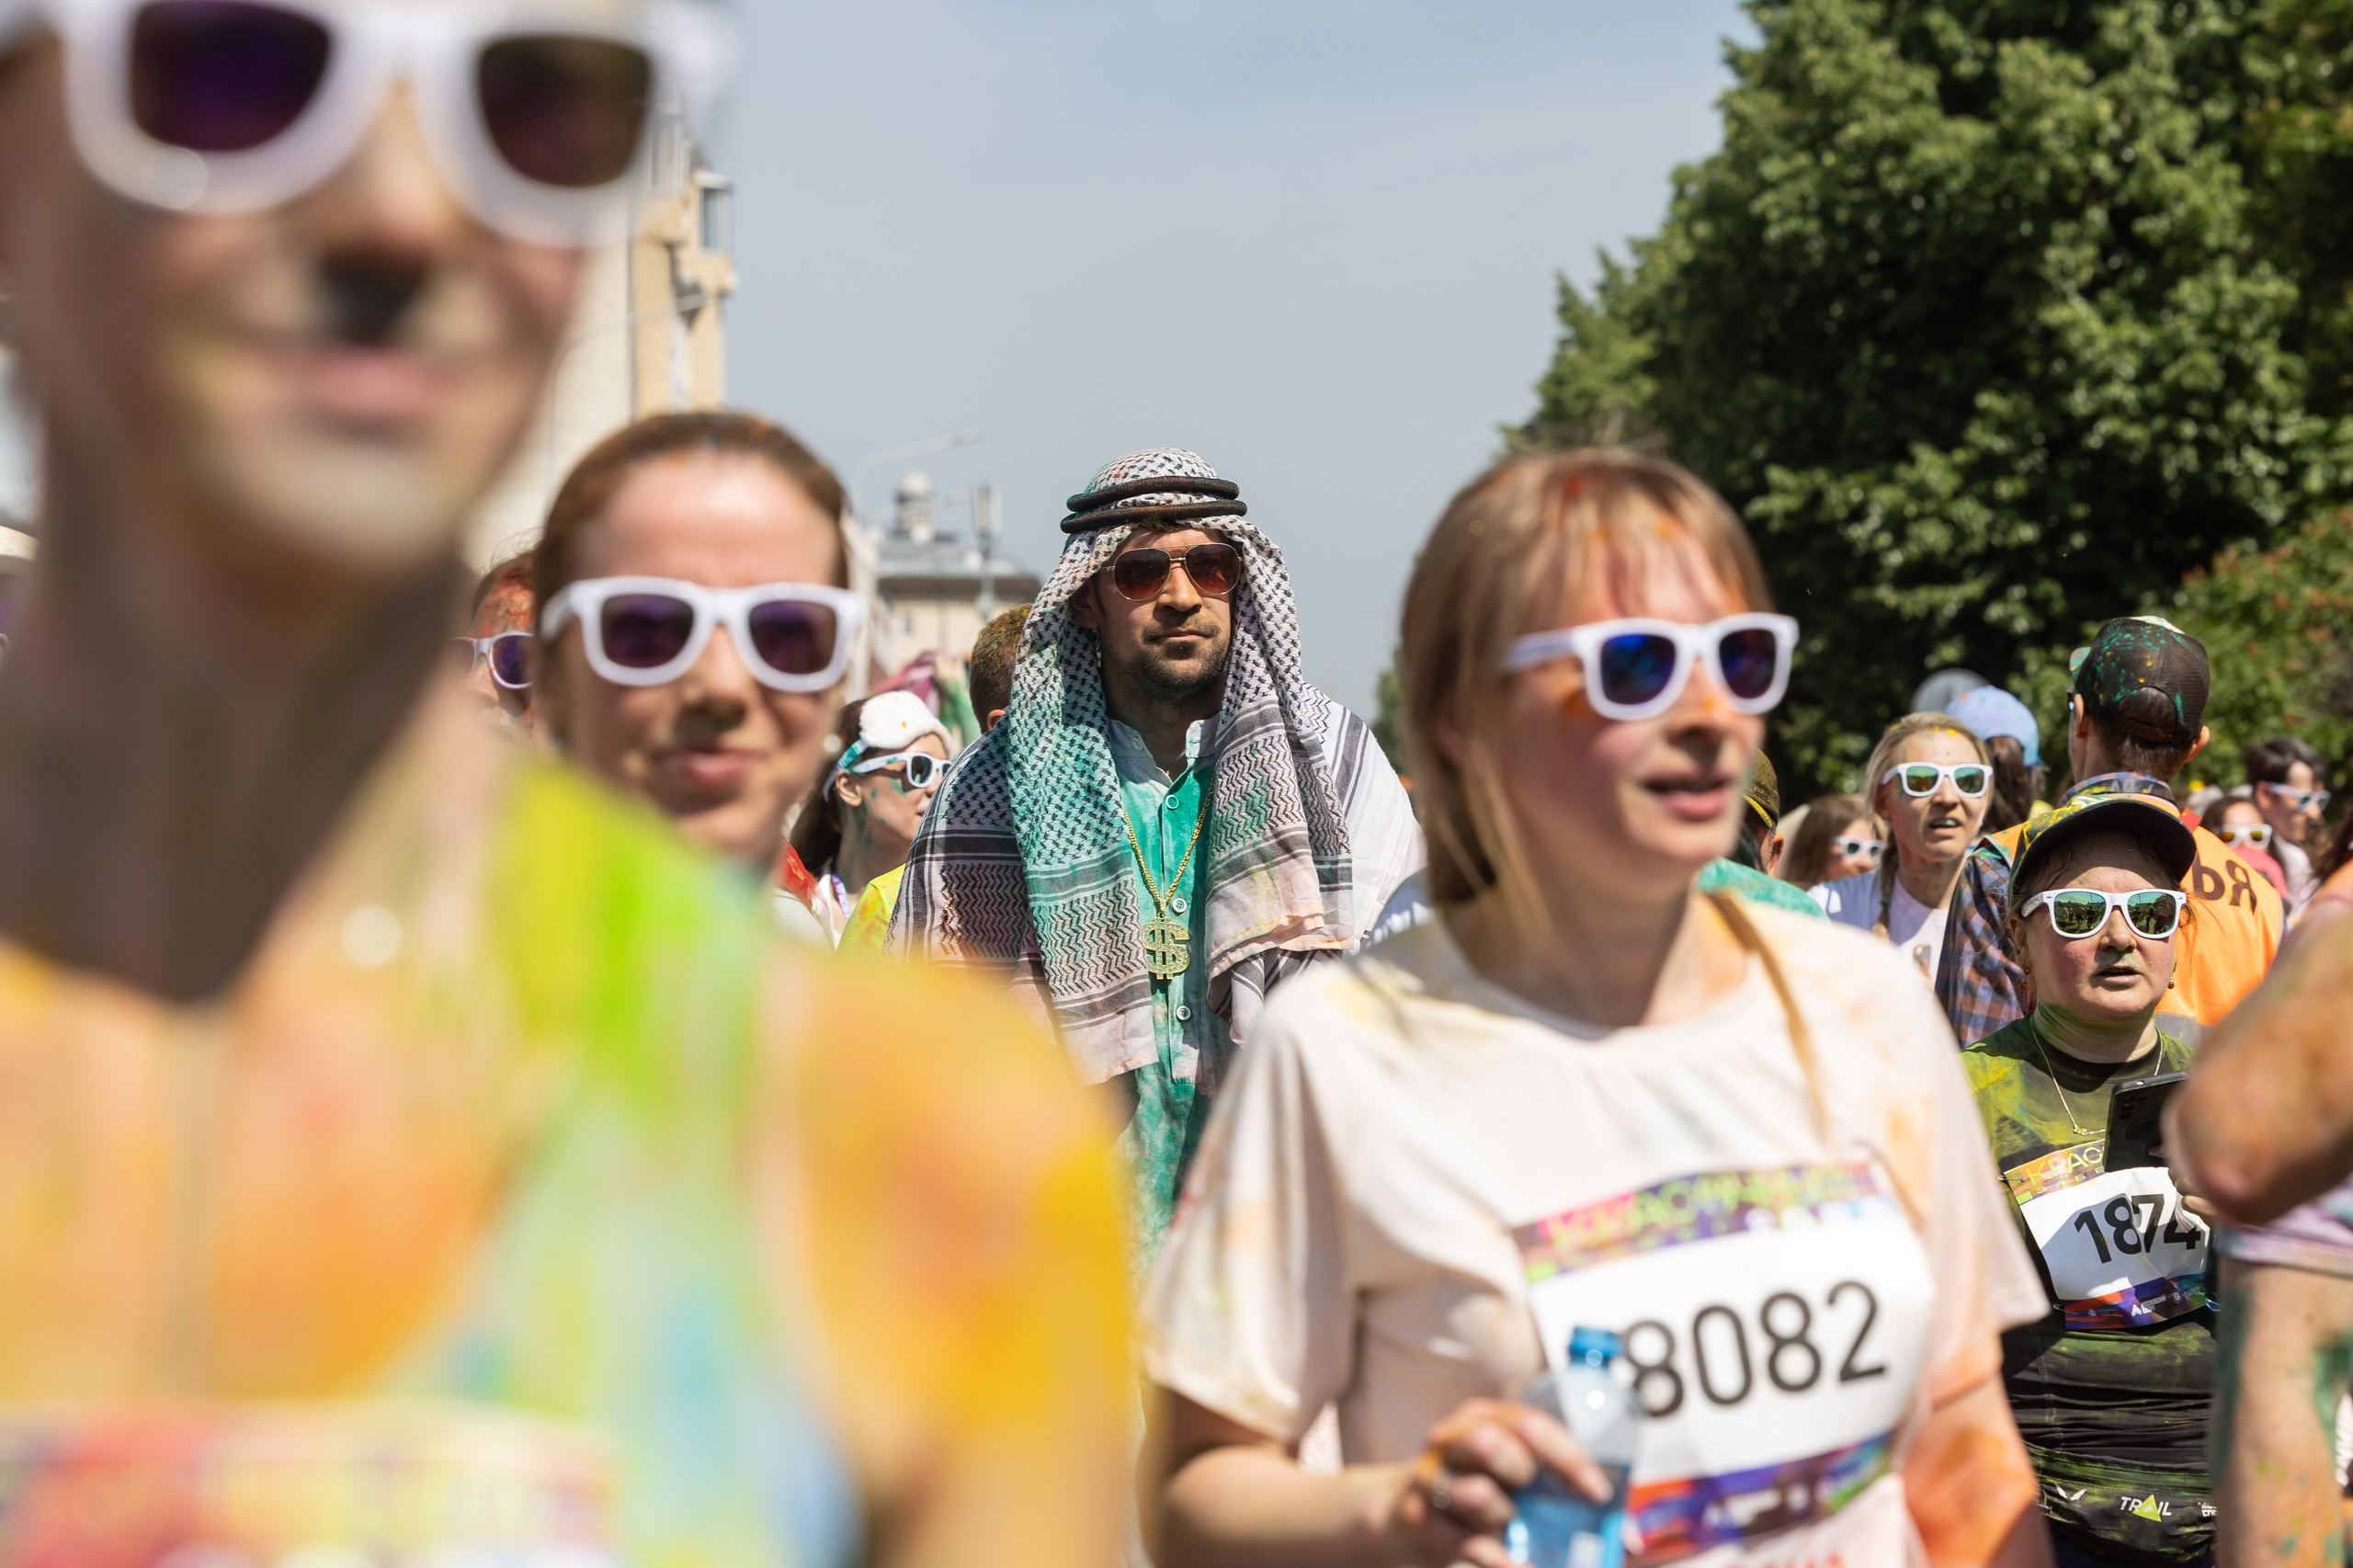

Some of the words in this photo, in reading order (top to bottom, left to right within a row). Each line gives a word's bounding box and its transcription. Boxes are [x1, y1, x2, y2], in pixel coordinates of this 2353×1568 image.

[2026, 1145, 2105, 1186] КРАС
[2036, 1165, 2105, 1194] ЗАБЕ
[2074, 1193, 2201, 1264] 1874
[1622, 1279, 1889, 1418] 8082
[2120, 1494, 2172, 1522] TRAIL
